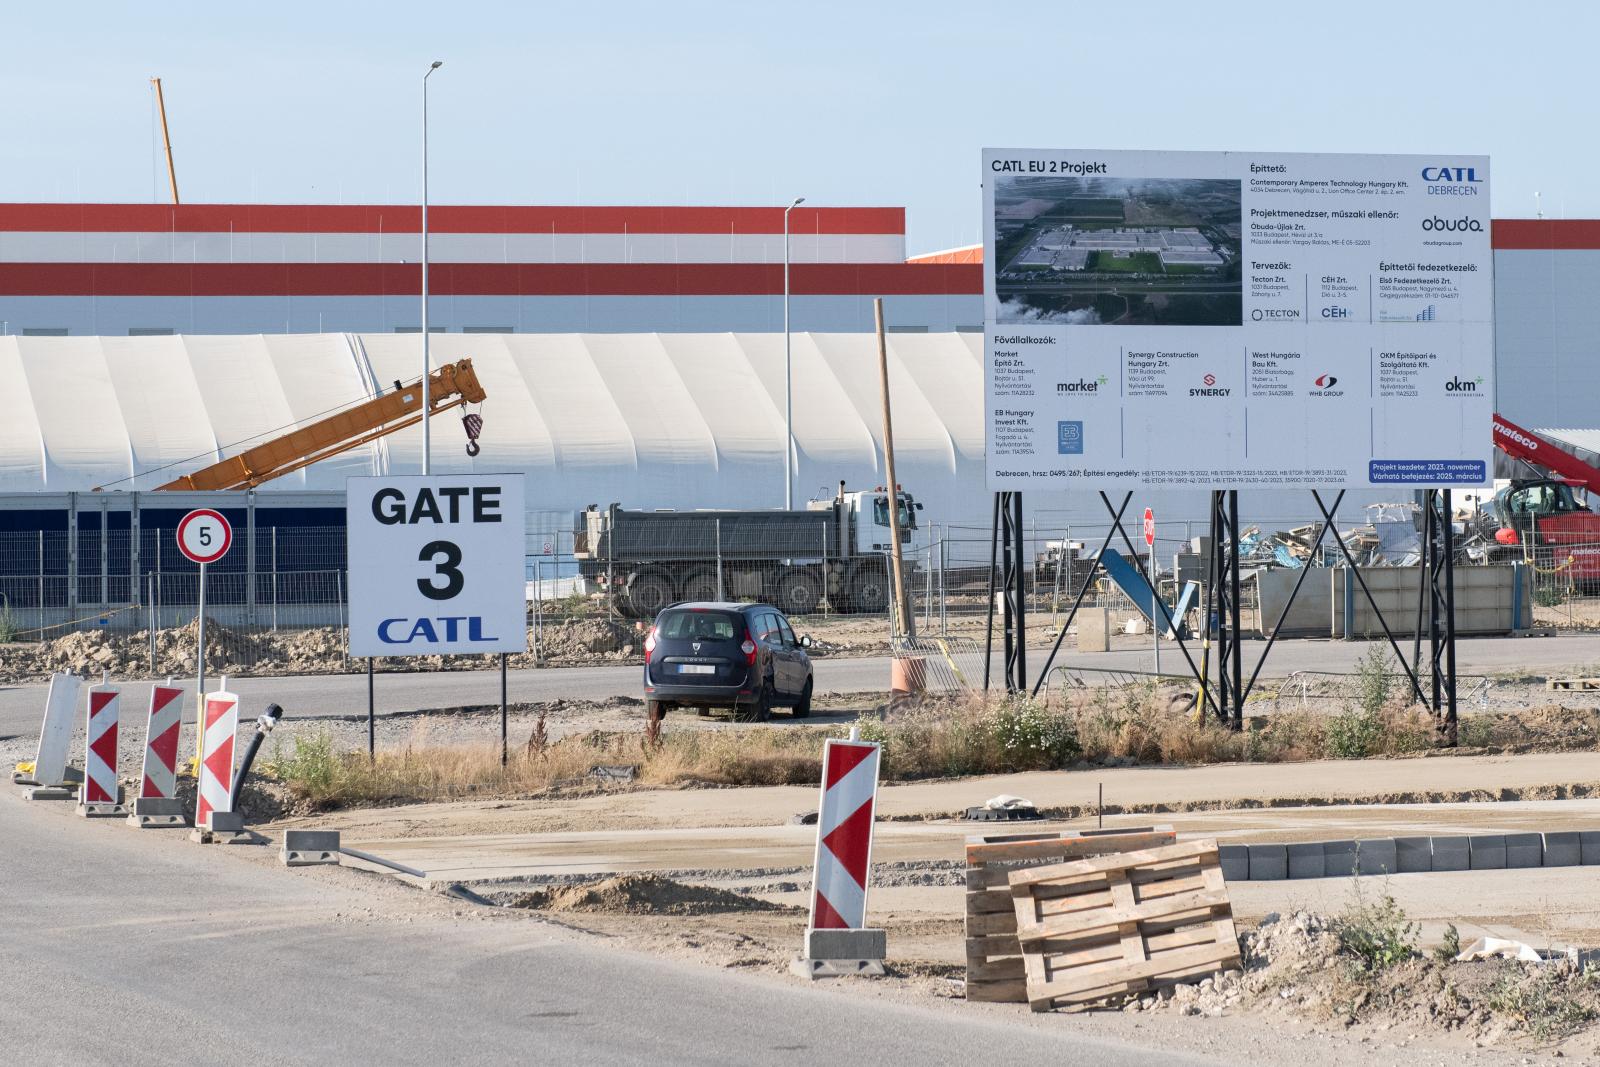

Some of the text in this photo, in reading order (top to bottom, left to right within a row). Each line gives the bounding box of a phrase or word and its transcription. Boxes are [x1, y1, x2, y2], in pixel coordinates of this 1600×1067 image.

[992, 160, 1106, 176] CATL EU 2 Projekt
[1250, 162, 1287, 174] Építtető:
[1422, 168, 1483, 182] CATL
[1250, 179, 1298, 187] Contemporary
[1300, 180, 1329, 188] Amperex
[1330, 180, 1367, 189] Technology
[1369, 181, 1396, 189] Hungary
[1428, 185, 1477, 195] DEBRECEN
[1250, 209, 1329, 219] Projektmenedzser,
[1251, 261, 1291, 270] Tervezők:
[1417, 263, 1478, 272] fedezetkezelő:
[1265, 309, 1300, 317] TECTON
[994, 336, 1056, 345] Fővállalkozók:
[994, 359, 1012, 367] Építő
[1380, 361, 1417, 369] Szolgáltató
[1057, 378, 1098, 391] market
[1446, 376, 1476, 391] okm
[1189, 388, 1230, 396] SYNERGY
[1493, 422, 1538, 450] mateco
[1083, 469, 1105, 478] Építési
[1107, 470, 1140, 478] engedély:
[1373, 472, 1400, 480] Várható
[372, 487, 502, 525] GATE
[200, 526, 211, 546] 5
[417, 540, 464, 600] 3
[377, 616, 499, 643] CATL
